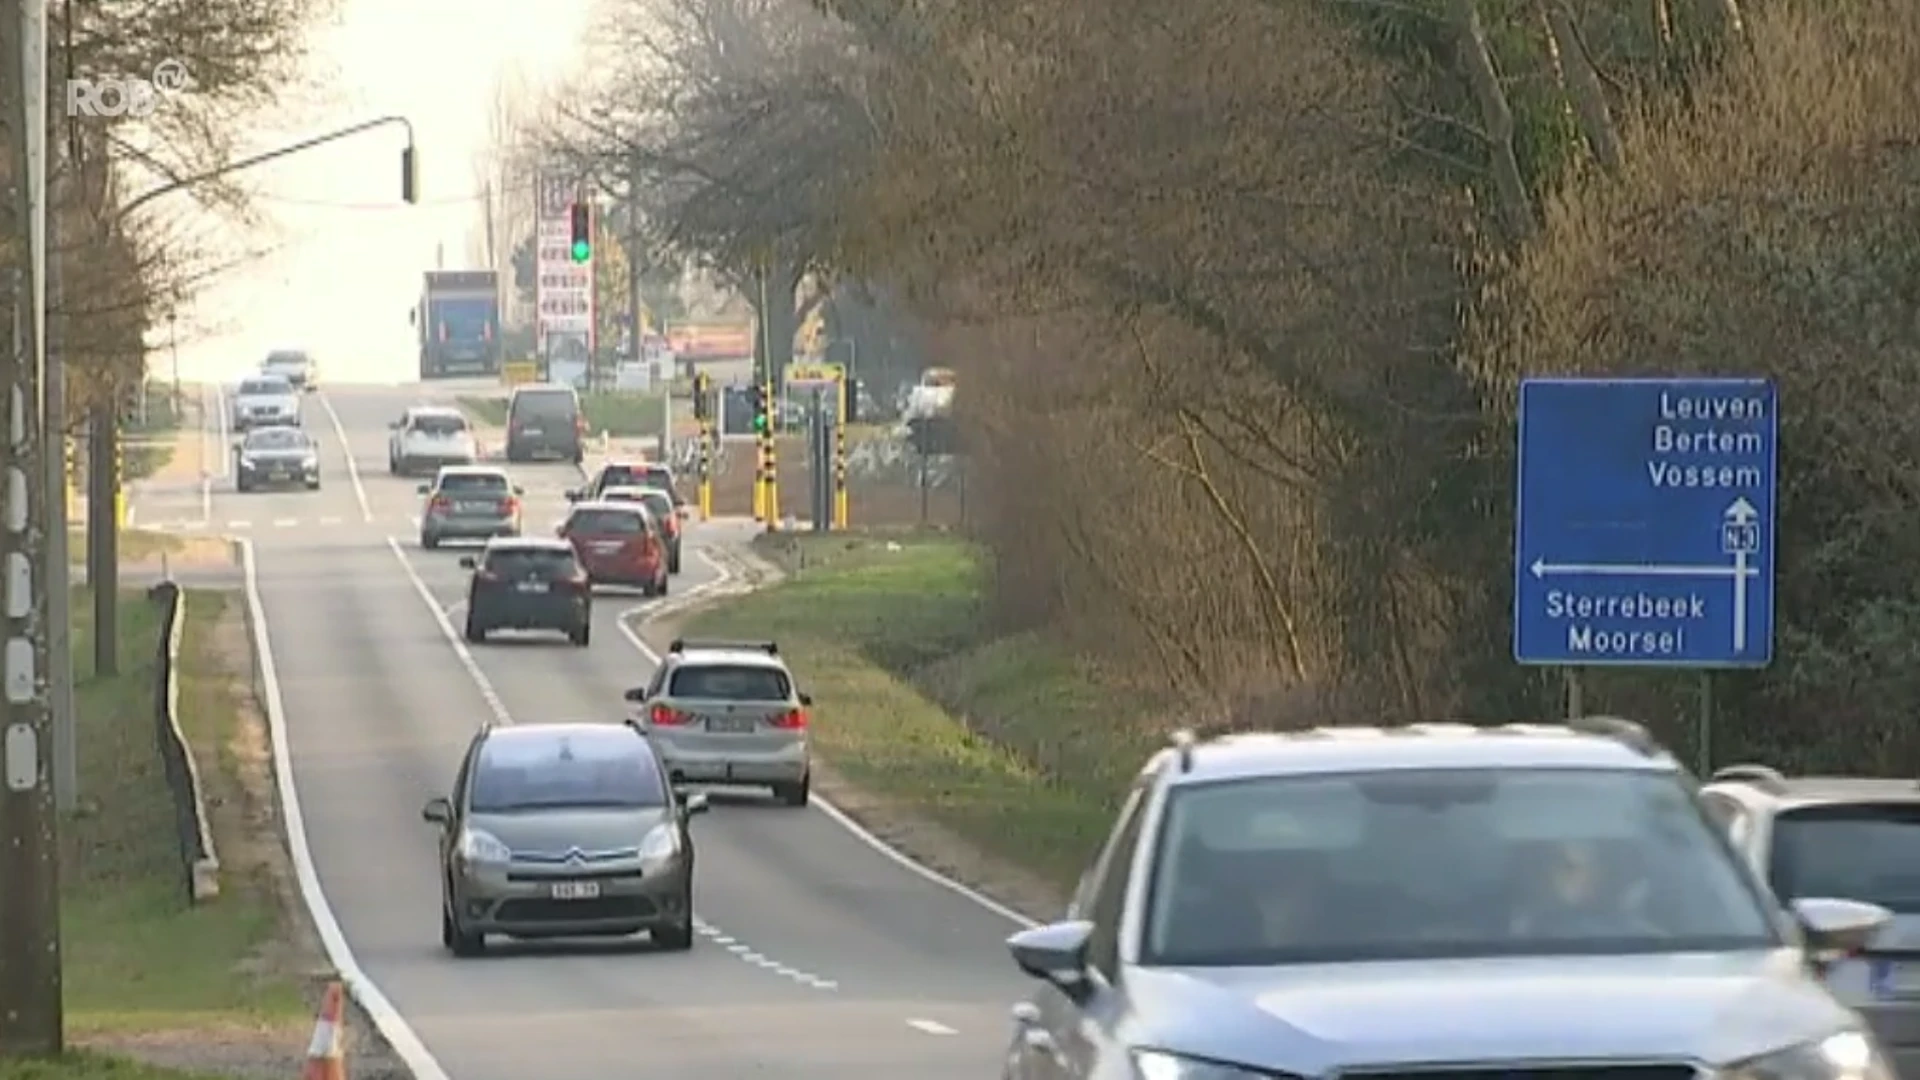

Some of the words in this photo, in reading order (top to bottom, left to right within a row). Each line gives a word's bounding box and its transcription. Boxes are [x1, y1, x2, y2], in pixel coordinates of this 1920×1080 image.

[1660, 391, 1764, 420] Leuven
[1655, 426, 1761, 452] Bertem
[1648, 461, 1760, 487] Vossem
[1546, 589, 1706, 618] Sterrebeek
[1568, 626, 1684, 653] Moorsel
